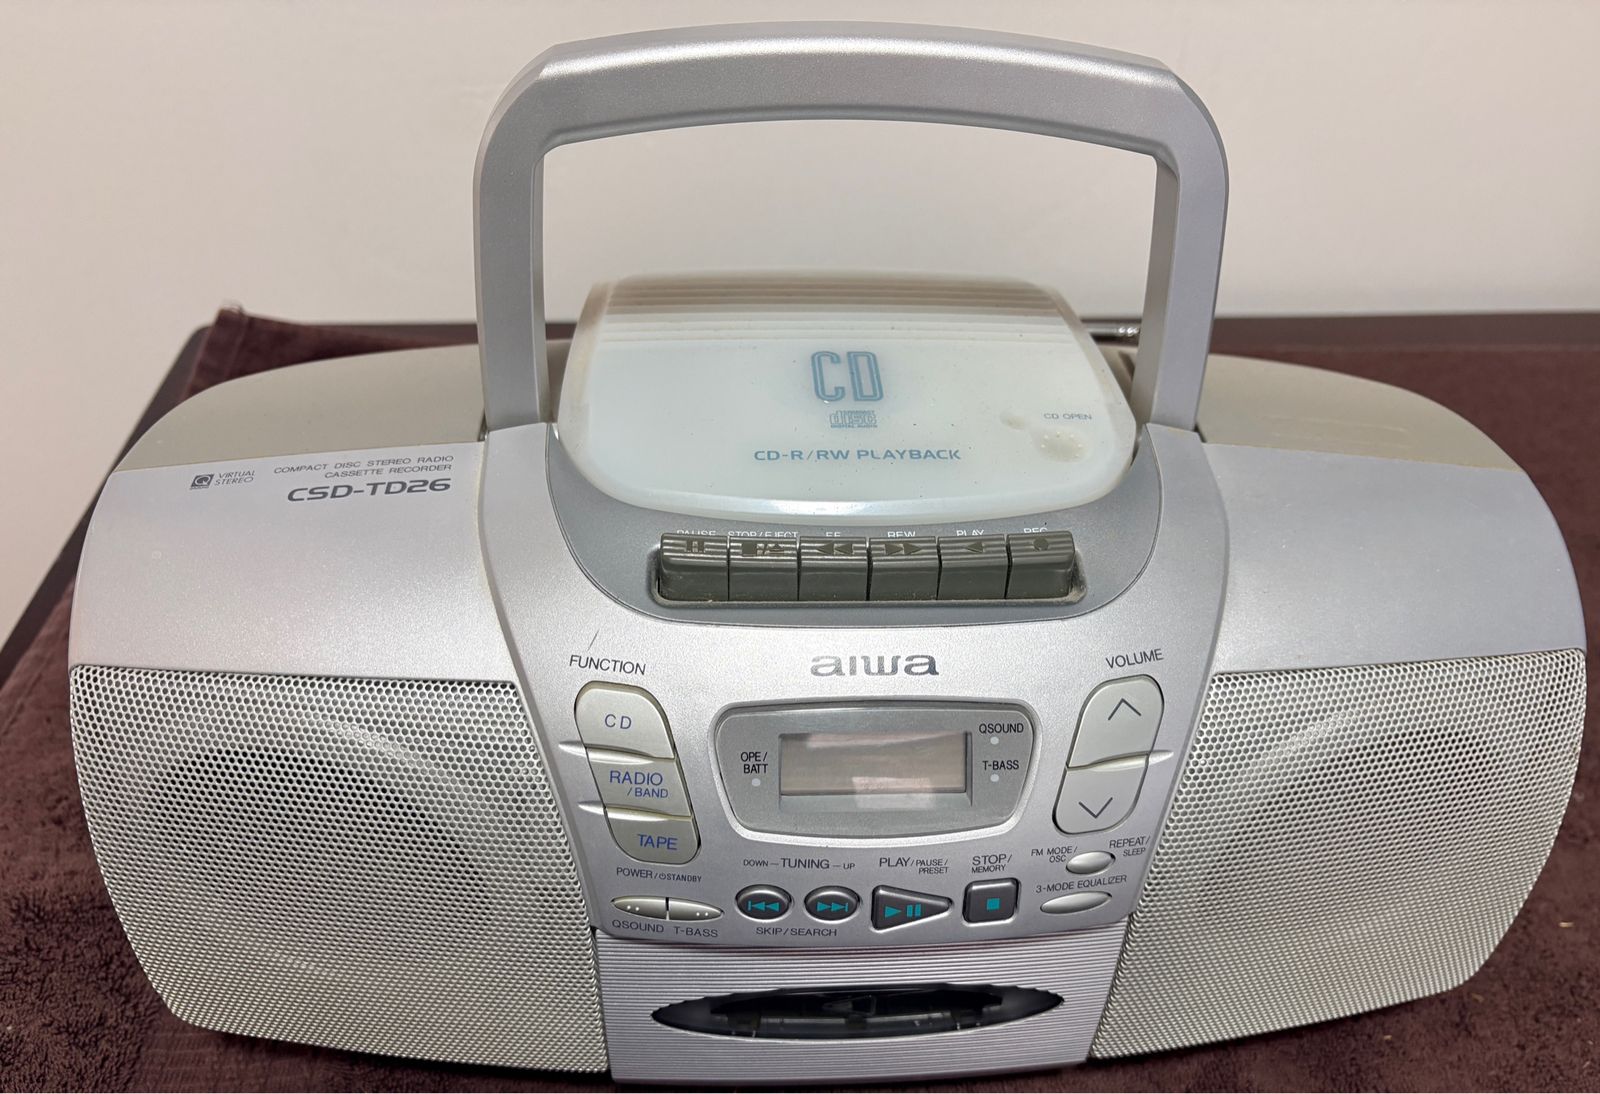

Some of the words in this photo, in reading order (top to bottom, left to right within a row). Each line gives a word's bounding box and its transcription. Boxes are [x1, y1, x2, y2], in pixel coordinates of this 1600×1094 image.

[811, 350, 884, 402] CD
[1044, 412, 1060, 420] CD
[1062, 412, 1092, 421] OPEN
[754, 449, 850, 462] CD-R/RW
[857, 449, 962, 461] PLAYBACK
[274, 463, 329, 474] COMPACT
[334, 461, 361, 469] DISC
[367, 457, 412, 467] STEREO
[417, 455, 454, 463] RADIO
[219, 470, 255, 479] VIRTUAL
[324, 468, 384, 479] CASSETTE
[388, 464, 452, 474] RECORDER
[214, 476, 254, 486] STEREO
[287, 478, 451, 502] CSD-TD26
[569, 655, 647, 676] FUNCTION
[810, 654, 938, 677] aiwa
[1106, 648, 1164, 670] VOLUME
[604, 714, 632, 729] CD
[978, 722, 1024, 736] QSOUND
[740, 751, 768, 763] OPE/
[743, 763, 768, 775] BATT
[982, 759, 1019, 771] T-BASS
[609, 770, 663, 786] RADIO
[627, 787, 669, 799] /BAND
[637, 834, 679, 850] TAPE
[1109, 836, 1151, 849] REPEAT/
[1031, 848, 1044, 856] FM
[1047, 846, 1078, 856] MODE/
[1122, 846, 1146, 857] SLEEP
[780, 857, 830, 870] TUNING
[971, 854, 1013, 866] STOP/
[1048, 854, 1067, 863] OSC
[918, 866, 949, 875] PRESET
[971, 863, 1006, 874] MEMORY
[1035, 882, 1075, 894] 3-MODE
[1077, 874, 1128, 889] EQUALIZER
[612, 919, 664, 934] QSOUND
[674, 926, 718, 938] T-BASS
[756, 926, 837, 937] SKIP/SEARCH
